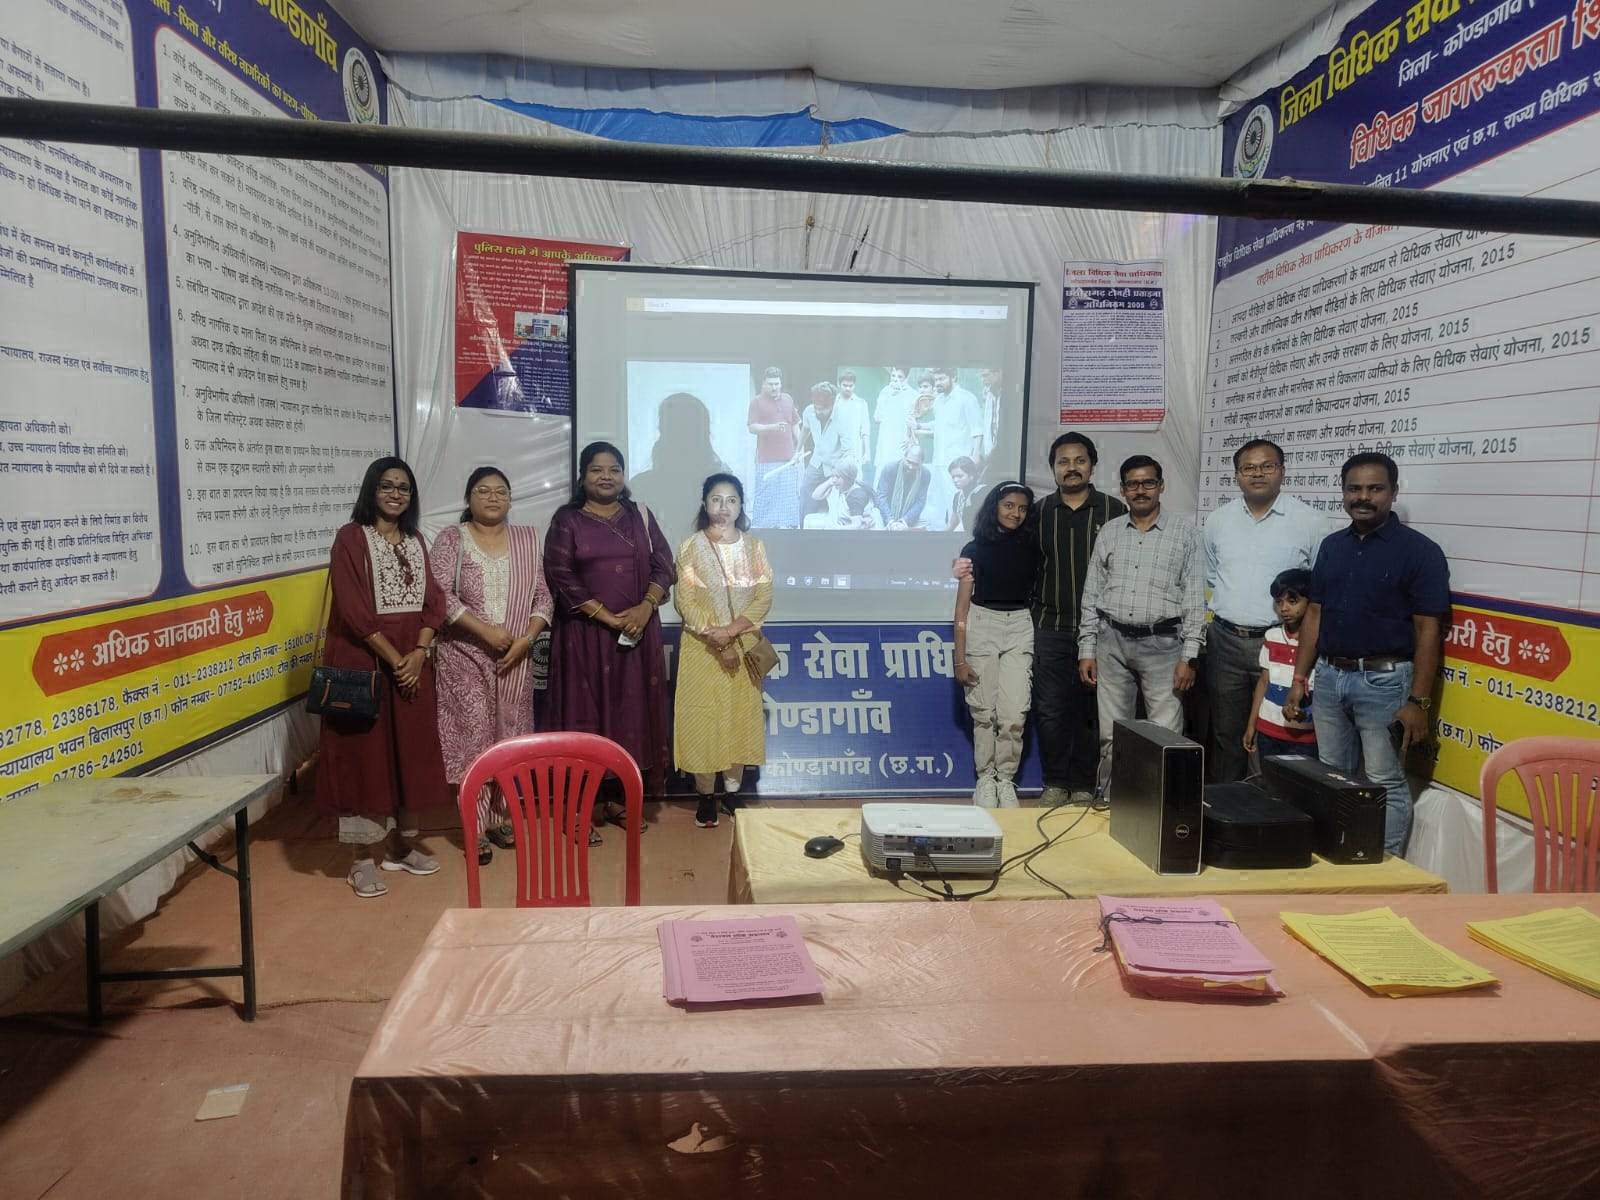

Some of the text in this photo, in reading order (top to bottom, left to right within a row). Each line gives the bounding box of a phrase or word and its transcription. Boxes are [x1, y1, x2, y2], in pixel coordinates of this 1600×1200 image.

[1278, 73, 1325, 134] जिला
[1326, 16, 1402, 100] विधिक
[1349, 101, 1419, 170] विधिक
[1394, 165, 1407, 184] 11
[1453, 129, 1470, 157] एवं
[1504, 102, 1536, 130] राज्य
[1540, 76, 1589, 114] विधिक
[474, 241, 502, 254] पुलिस
[506, 245, 526, 256] थाने
[1360, 259, 1386, 280] माध्यम
[1388, 250, 1398, 270] से
[1401, 241, 1432, 264] विधिक
[1360, 282, 1375, 304] लिए
[1377, 277, 1407, 297] विधिक
[1480, 242, 1516, 267] 2015
[1313, 324, 1336, 343] विधिक
[1392, 302, 1419, 322] 2015
[1370, 337, 1379, 353] के
[1382, 331, 1399, 350] लिए
[1438, 317, 1470, 339] 2015
[1401, 360, 1410, 374] के
[1412, 356, 1431, 374] लिए
[1433, 349, 1467, 370] विधिक
[1503, 332, 1545, 356] योजना,
[1551, 326, 1591, 350] 2015
[1384, 387, 1411, 404] 2015
[25, 420, 56, 435] अधिकारी
[1320, 424, 1332, 440] और
[1391, 418, 1418, 434] 2015
[1481, 437, 1517, 455] 2015
[26, 444, 57, 455] न्यायालय
[59, 441, 81, 455] विधिक
[12, 463, 43, 475] न्यायालय
[7, 517, 18, 534] एवं
[21, 519, 41, 535] सुरक्षा
[44, 519, 61, 530] प्रदान
[63, 515, 79, 528] करने
[22, 537, 32, 551] की
[58, 534, 75, 548] ताकि
[19, 577, 39, 592] कराने
[55, 574, 78, 588] आवेदन
[92, 604, 244, 667] अधिक जानकारी हेतु
[1482, 622, 1512, 665] हेतु
[802, 630, 870, 680] सेवा
[52, 697, 119, 730] 23386178,
[122, 688, 149, 705] फैक्स
[58, 735, 85, 755] भवन
[89, 717, 135, 745] बिलासपुर
[138, 704, 168, 730] (छ.ग.)
[170, 695, 189, 714] फोन
[766, 748, 953, 778] कोण्डागाँव (छ.ग.)
